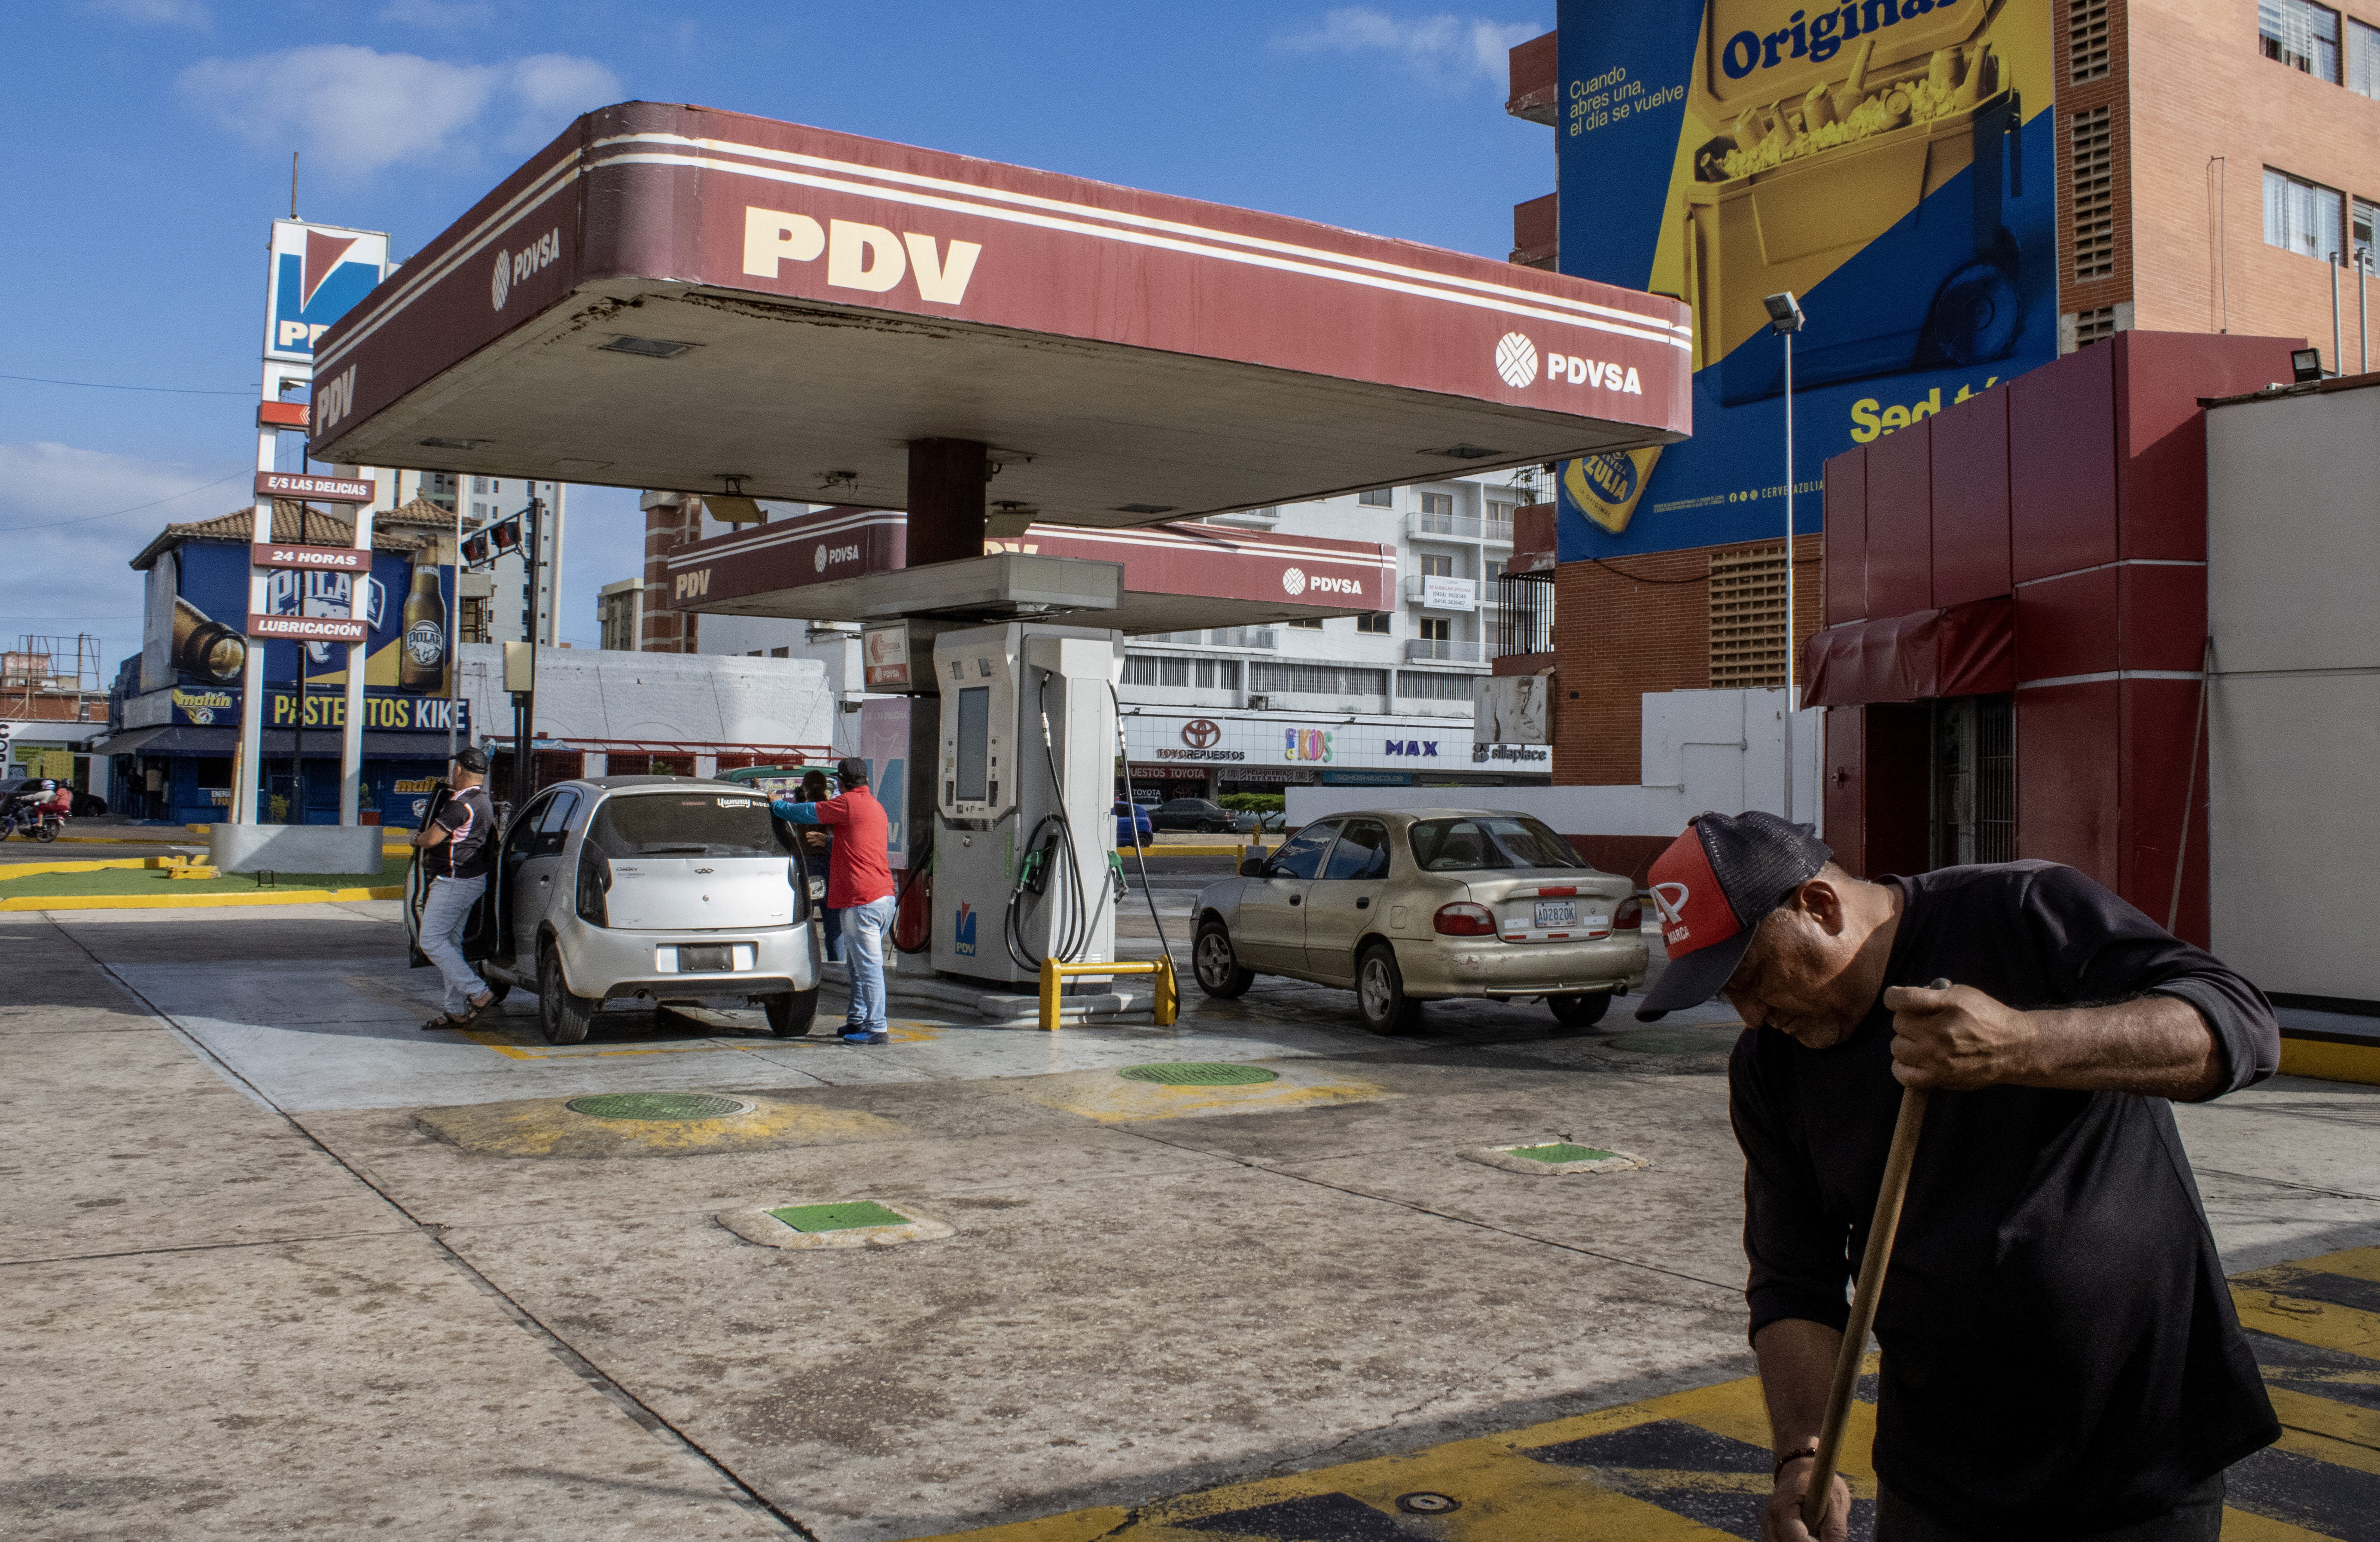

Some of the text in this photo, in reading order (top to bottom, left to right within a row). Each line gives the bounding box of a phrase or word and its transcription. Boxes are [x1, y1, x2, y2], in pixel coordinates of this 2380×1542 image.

[1722, 0, 1957, 79] Origina
[1570, 66, 1626, 99] Cuando
[1570, 81, 1645, 118] abres una,
[1570, 85, 1683, 136] el día se vuelve
[513, 227, 560, 286] PDVSA
[744, 206, 982, 305] PDV
[1548, 353, 1643, 395] PDVSA
[316, 365, 357, 437] PDV
[268, 476, 367, 496] E/S LAS DELICIAS
[1584, 455, 1628, 501] ZULIA
[1762, 480, 1823, 499] CERVEAZULIA
[272, 551, 357, 565] 24 HORAS
[829, 545, 859, 565] PDVSA
[675, 569, 711, 600] PDV
[1310, 576, 1362, 595] PDVSA
[258, 620, 362, 636] LUBRICACIÓN
[409, 631, 441, 649] POLAR
[883, 669, 899, 678] PDVSA
[178, 692, 232, 708] maltín
[415, 699, 466, 729] KIKE
[1158, 749, 1245, 760] TOYOREPUESTOS
[1386, 740, 1438, 756] MAX
[1491, 745, 1546, 763] sillaplace
[1170, 768, 1205, 779] TOYOTA
[717, 798, 750, 808] Yummy
[1667, 925, 1691, 945] MARCA
[956, 942, 975, 954] PDV
